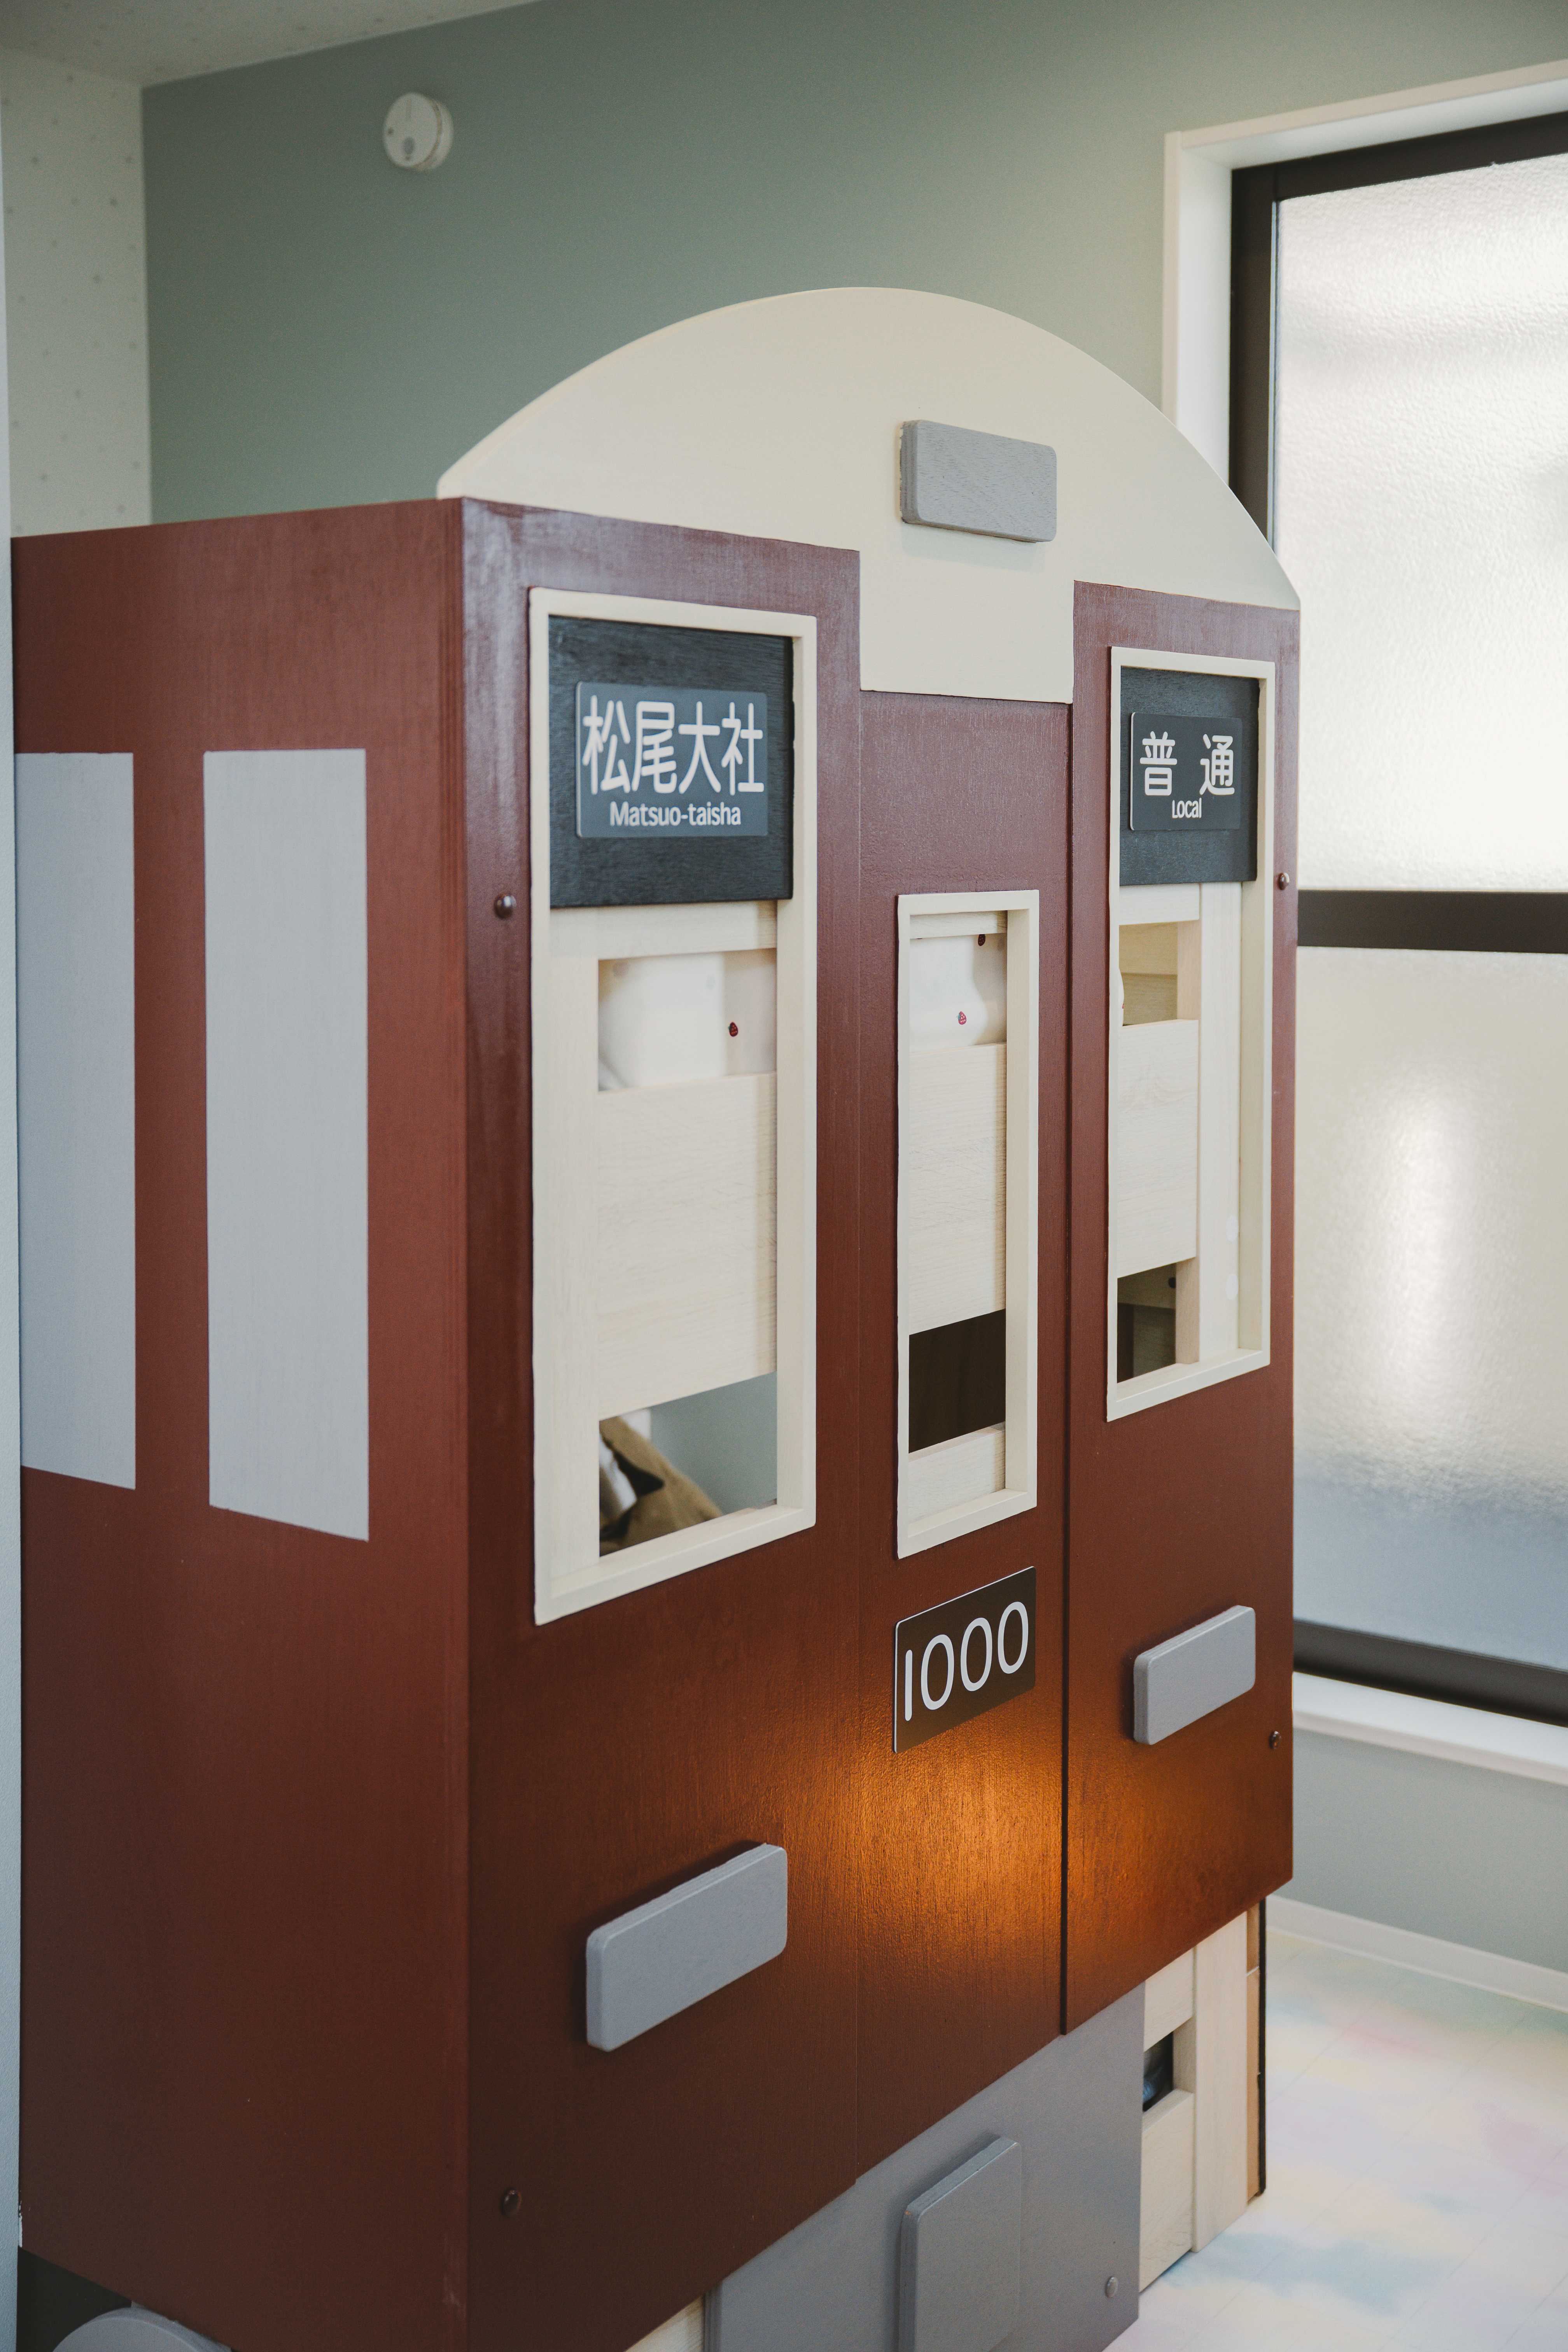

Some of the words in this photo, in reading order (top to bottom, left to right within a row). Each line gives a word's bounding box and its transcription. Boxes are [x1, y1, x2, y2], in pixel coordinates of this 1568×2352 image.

[583, 695, 765, 795] 松尾大社
[1140, 731, 1235, 796] 普通
[610, 801, 741, 826] Matsuo-taisha
[1172, 797, 1202, 819] Local
[905, 1601, 1029, 1721] 1000
